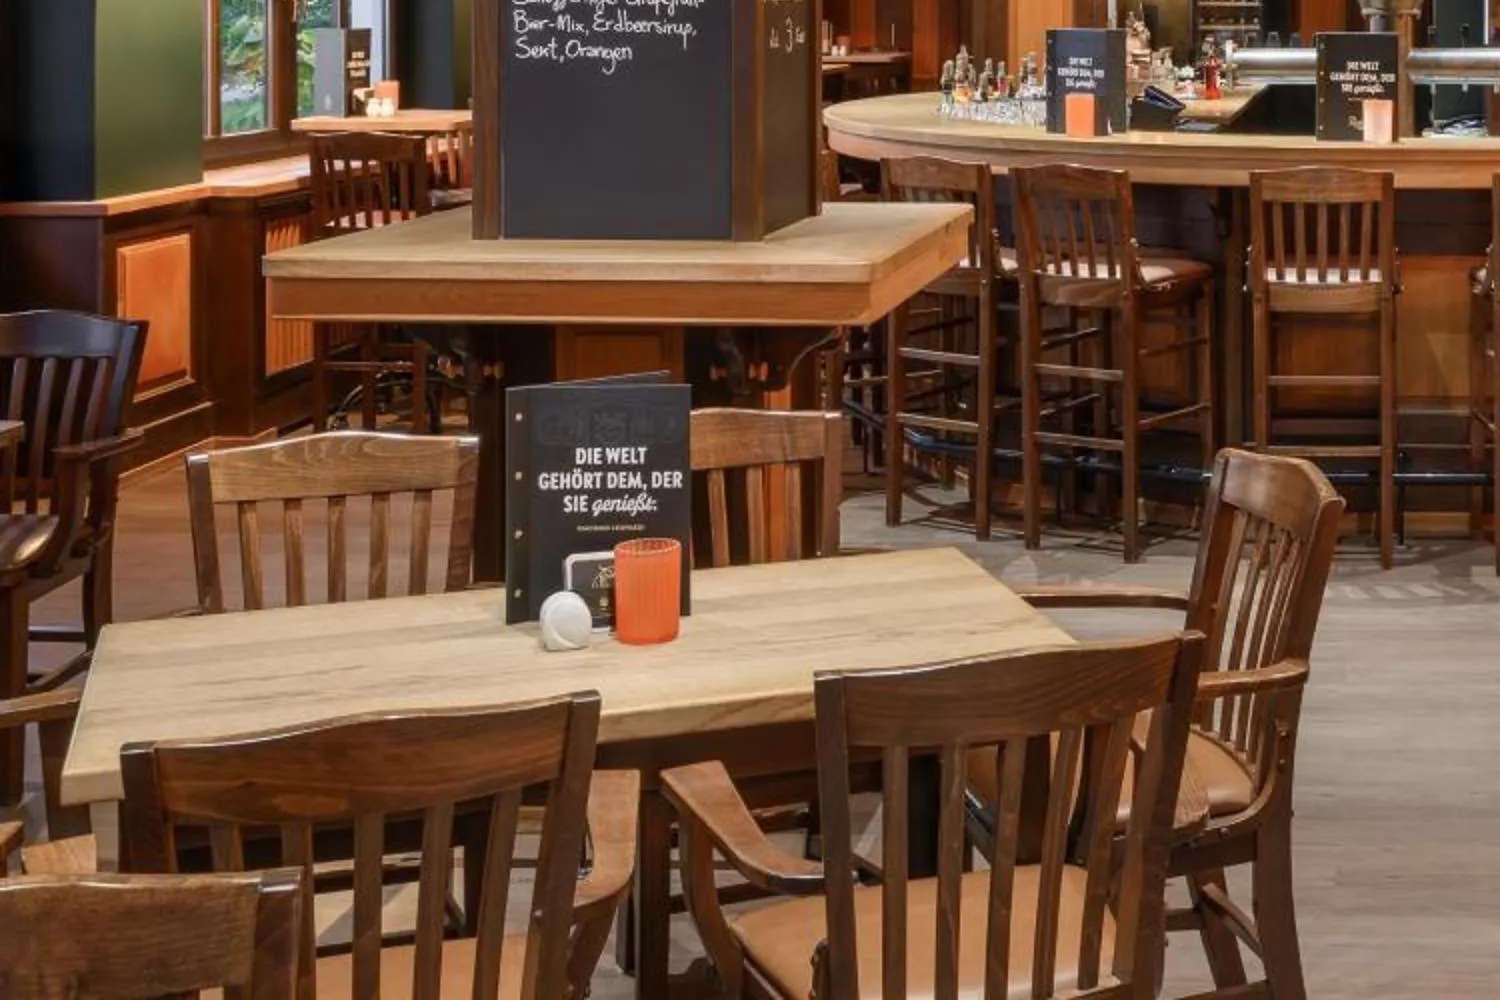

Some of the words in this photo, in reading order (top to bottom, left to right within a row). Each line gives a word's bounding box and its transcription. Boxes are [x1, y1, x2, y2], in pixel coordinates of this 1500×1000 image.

[565, 39, 633, 75] Orangen
[575, 447, 602, 465] DIE
[605, 447, 648, 465] WELT
[538, 469, 602, 490] GEHÖRT
[606, 471, 647, 491] DEM,
[651, 471, 683, 488] DER
[563, 495, 588, 512] SIE
